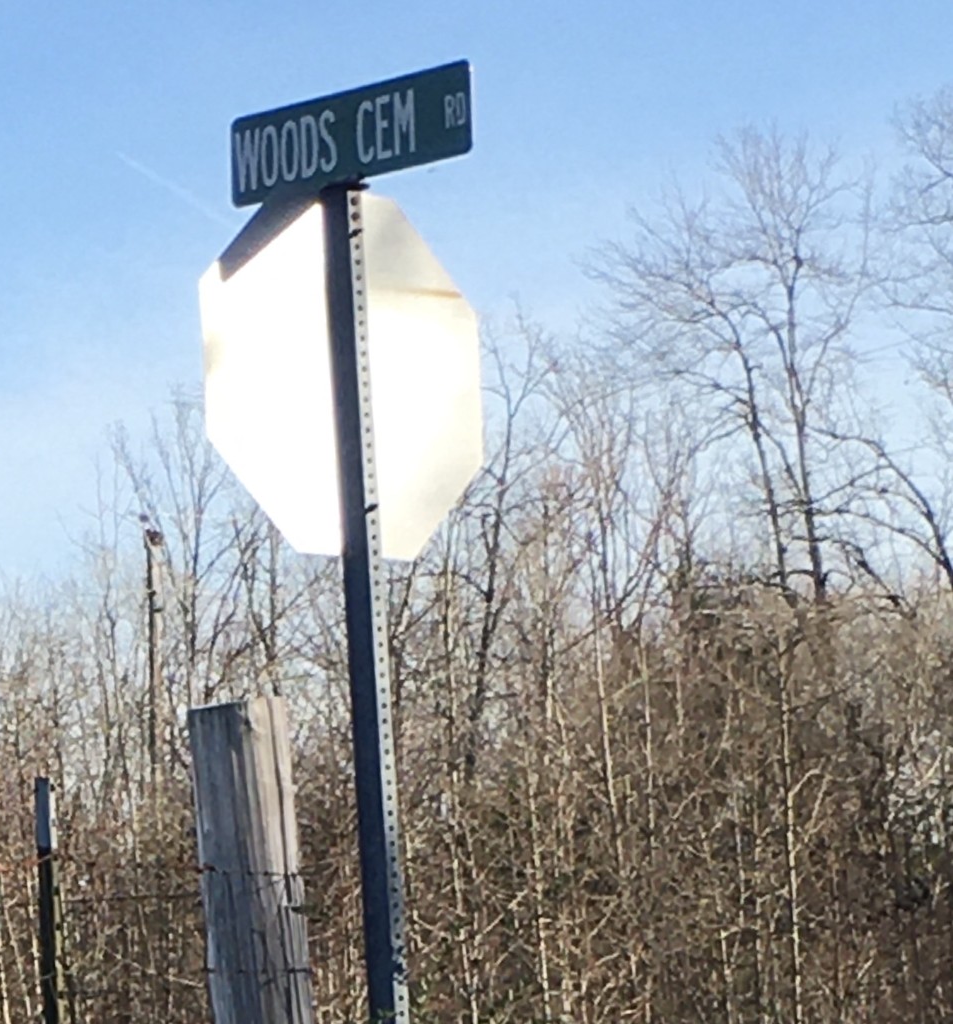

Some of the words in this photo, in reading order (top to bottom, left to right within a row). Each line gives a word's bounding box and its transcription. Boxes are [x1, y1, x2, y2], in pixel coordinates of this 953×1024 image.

[235, 109, 338, 193] WOODS
[356, 87, 416, 164] CEM
[444, 92, 466, 129] RD
